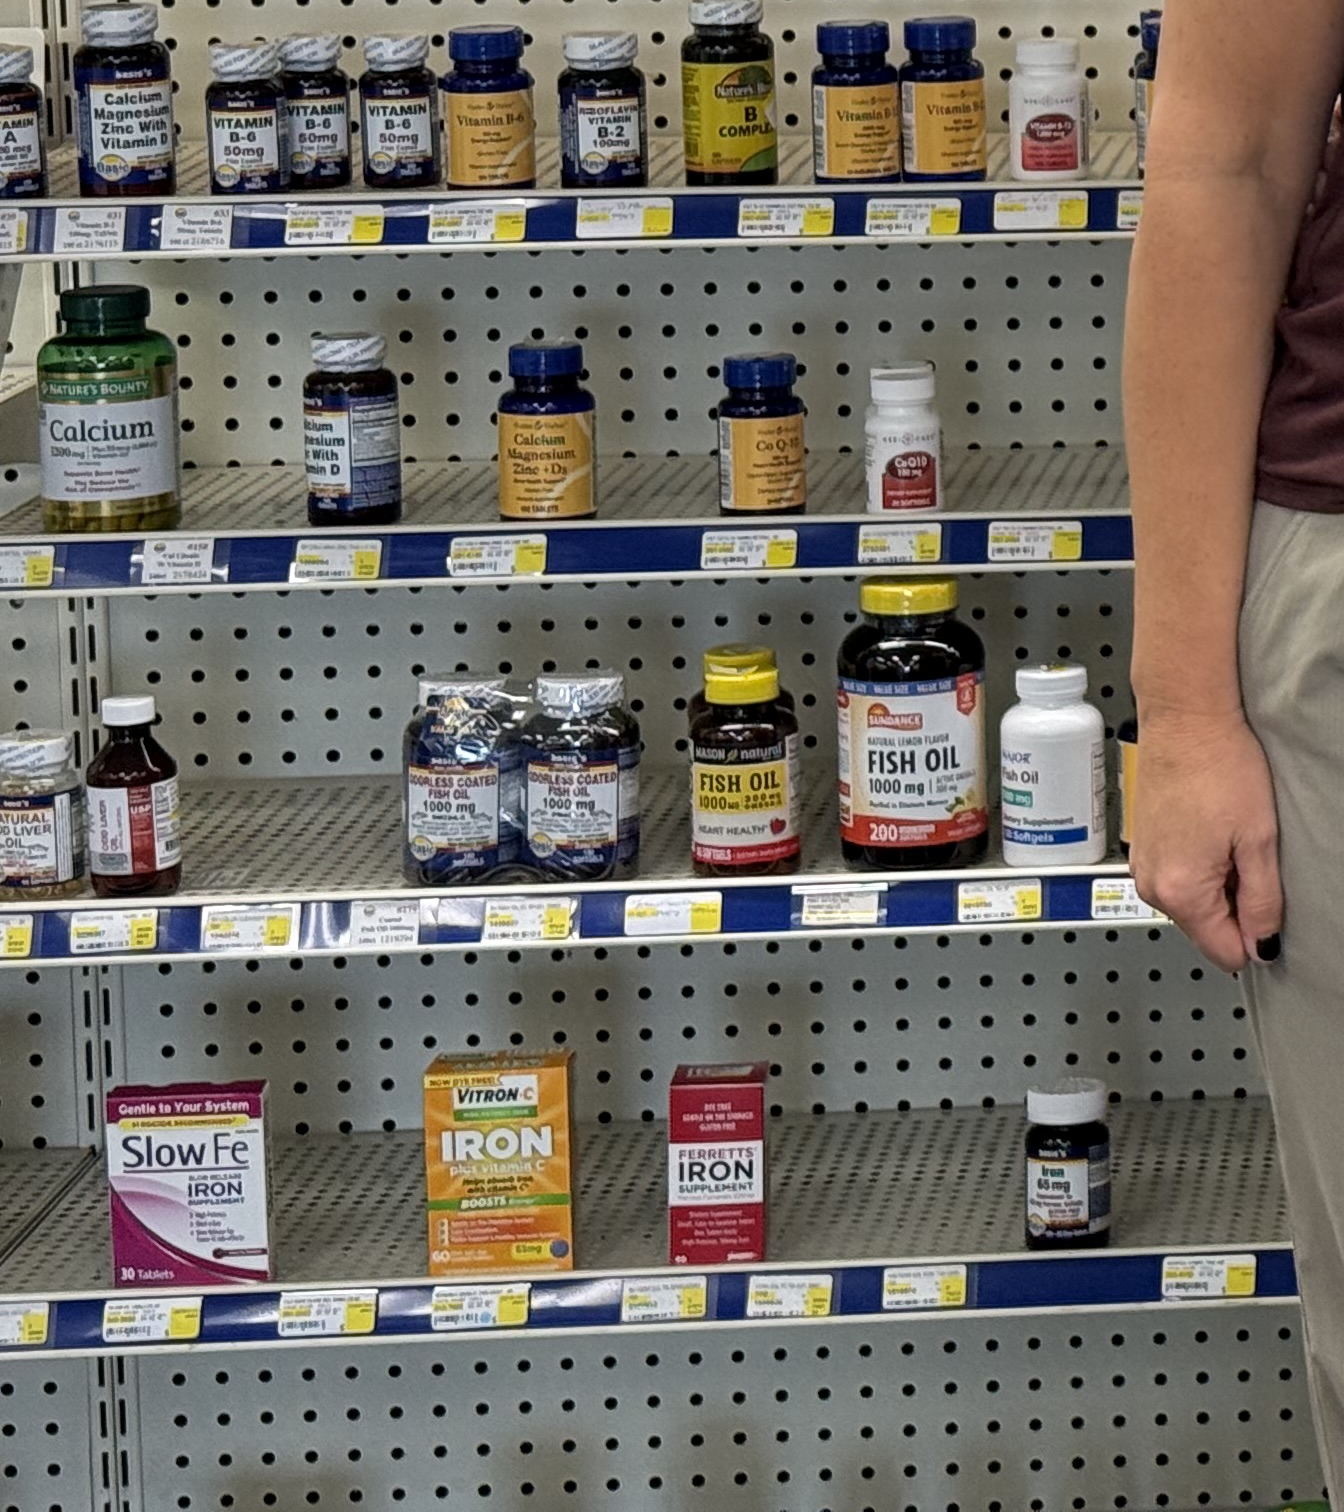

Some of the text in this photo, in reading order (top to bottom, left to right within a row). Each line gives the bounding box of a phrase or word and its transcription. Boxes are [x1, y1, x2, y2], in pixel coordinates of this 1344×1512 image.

[104, 91, 163, 105] Calcium
[93, 105, 170, 123] Magnesium
[286, 104, 345, 117] VITAMIN
[368, 104, 427, 117] VITAMIN
[744, 106, 758, 122] B
[926, 102, 972, 115] Vitamin
[214, 116, 273, 130] VITAMIN
[456, 112, 525, 128] Vitamin B-6
[588, 115, 632, 125] VITAMIN
[836, 110, 883, 122] Vitamin
[101, 120, 167, 135] Zinc With
[305, 119, 332, 130] B-6
[384, 119, 412, 130] B-6
[379, 132, 419, 145] 50mg
[597, 126, 625, 138] B-2
[101, 135, 168, 150] Vitamin D
[224, 145, 265, 158] 50mg
[50, 380, 150, 396] NATURE'S BOUNTY
[49, 418, 154, 442] Calcium
[513, 433, 566, 446] Calcium
[312, 449, 339, 462] With
[507, 448, 576, 462] Magnesium
[330, 463, 341, 476] D
[868, 714, 922, 725] SUNDANCE
[740, 741, 783, 760] natural
[867, 745, 961, 774] FISH OIL
[457, 774, 497, 788] COATED
[576, 772, 618, 784] COATED
[699, 770, 781, 793] FISH OIL
[1021, 770, 1039, 784] Oil
[428, 788, 471, 800] FISH OIL
[548, 786, 590, 798] FISH OIL
[869, 778, 925, 796] 1000 mg
[423, 800, 476, 814] 1000 mg
[542, 798, 596, 812] 1000 mg
[14, 824, 52, 835] LIVER
[869, 822, 899, 841] 200
[1014, 831, 1055, 845] Softgels
[118, 1099, 250, 1115] Gentle to Your System
[121, 1133, 250, 1168] Slow Fe
[441, 1125, 553, 1162] IRON
[678, 1146, 754, 1160] FERRETTS
[450, 1160, 546, 1176] plus vitamin C
[678, 1160, 754, 1182] IRON
[1041, 1165, 1065, 1178] Iron
[188, 1182, 243, 1197] IRON
[678, 1181, 754, 1194] SUPPLEMENT
[1051, 1181, 1071, 1193] mg
[188, 1196, 246, 1206] SUPPLEMENT
[460, 1195, 507, 1209] BOOSTS
[120, 1267, 175, 1280] 30 Tablets
